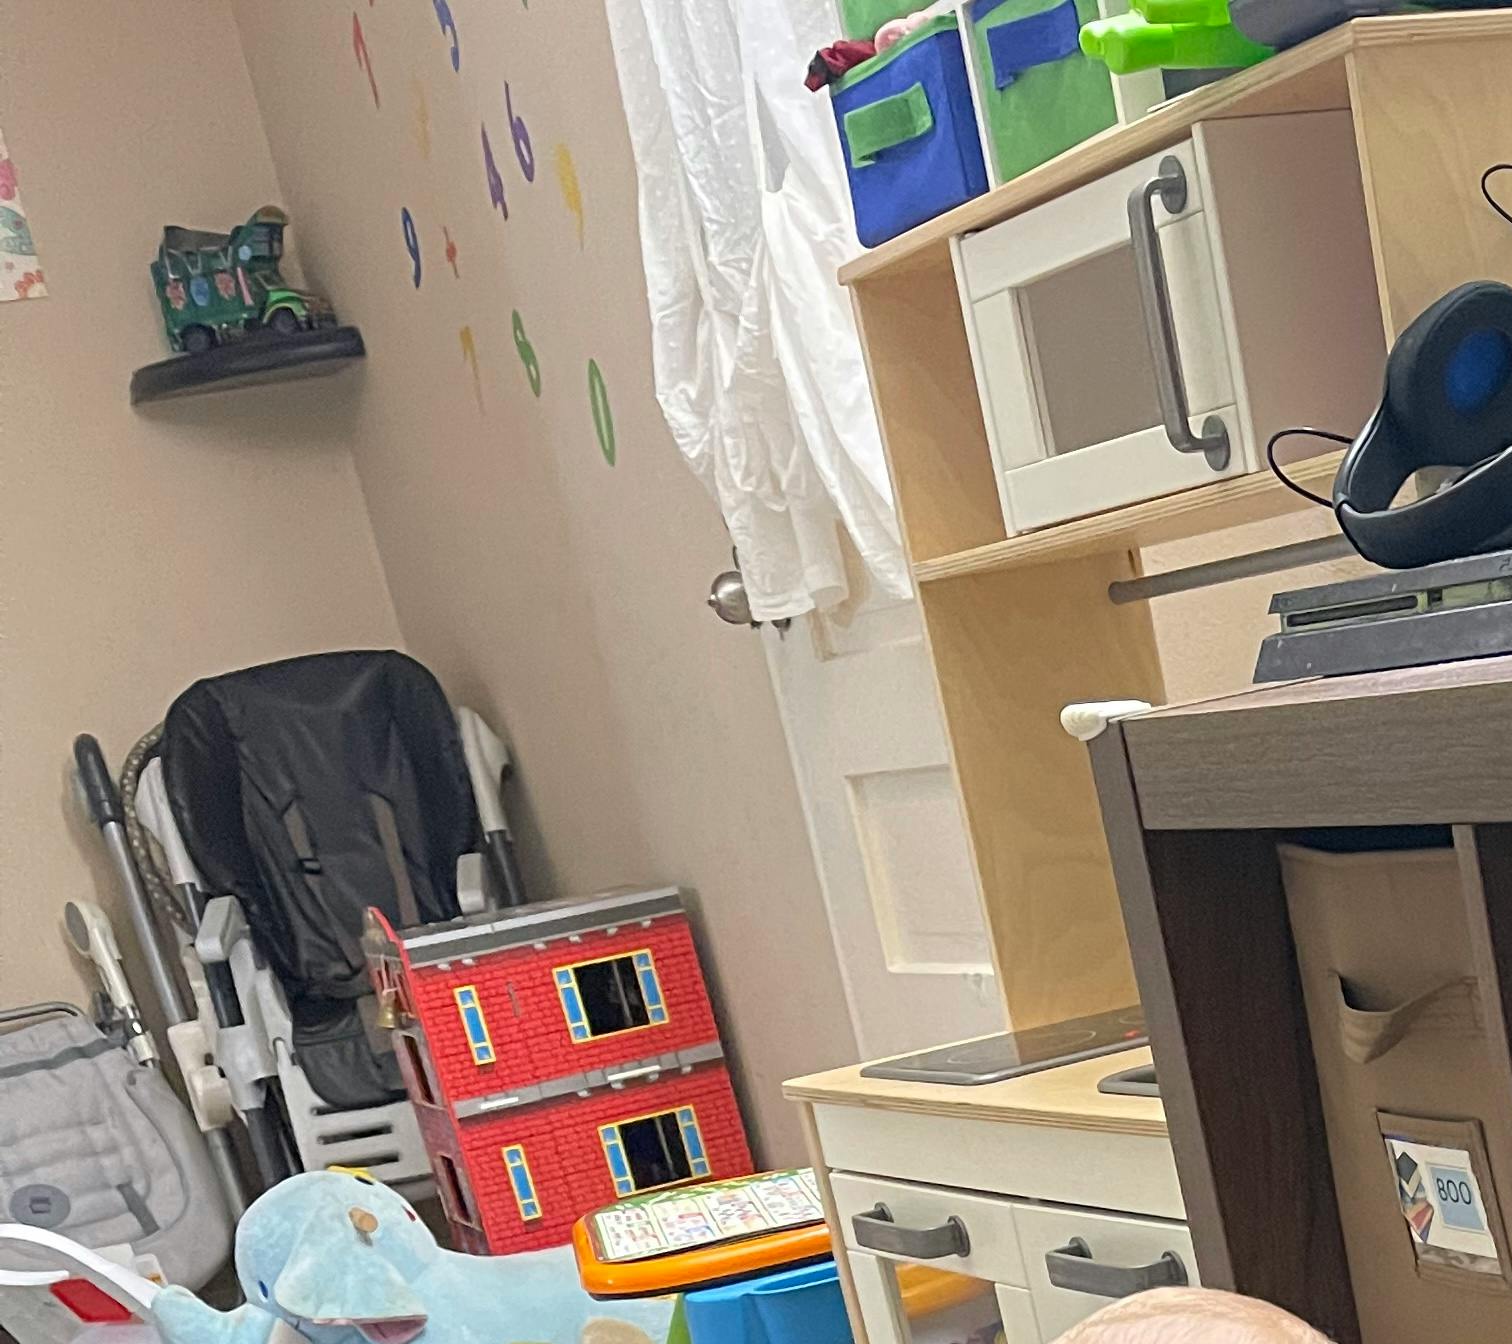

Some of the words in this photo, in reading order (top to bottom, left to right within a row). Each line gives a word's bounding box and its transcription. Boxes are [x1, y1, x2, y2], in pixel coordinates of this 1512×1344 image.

[504, 80, 535, 183] 6
[401, 206, 421, 289] 9
[511, 308, 541, 398] 8
[1436, 1177, 1472, 1205] BOO
